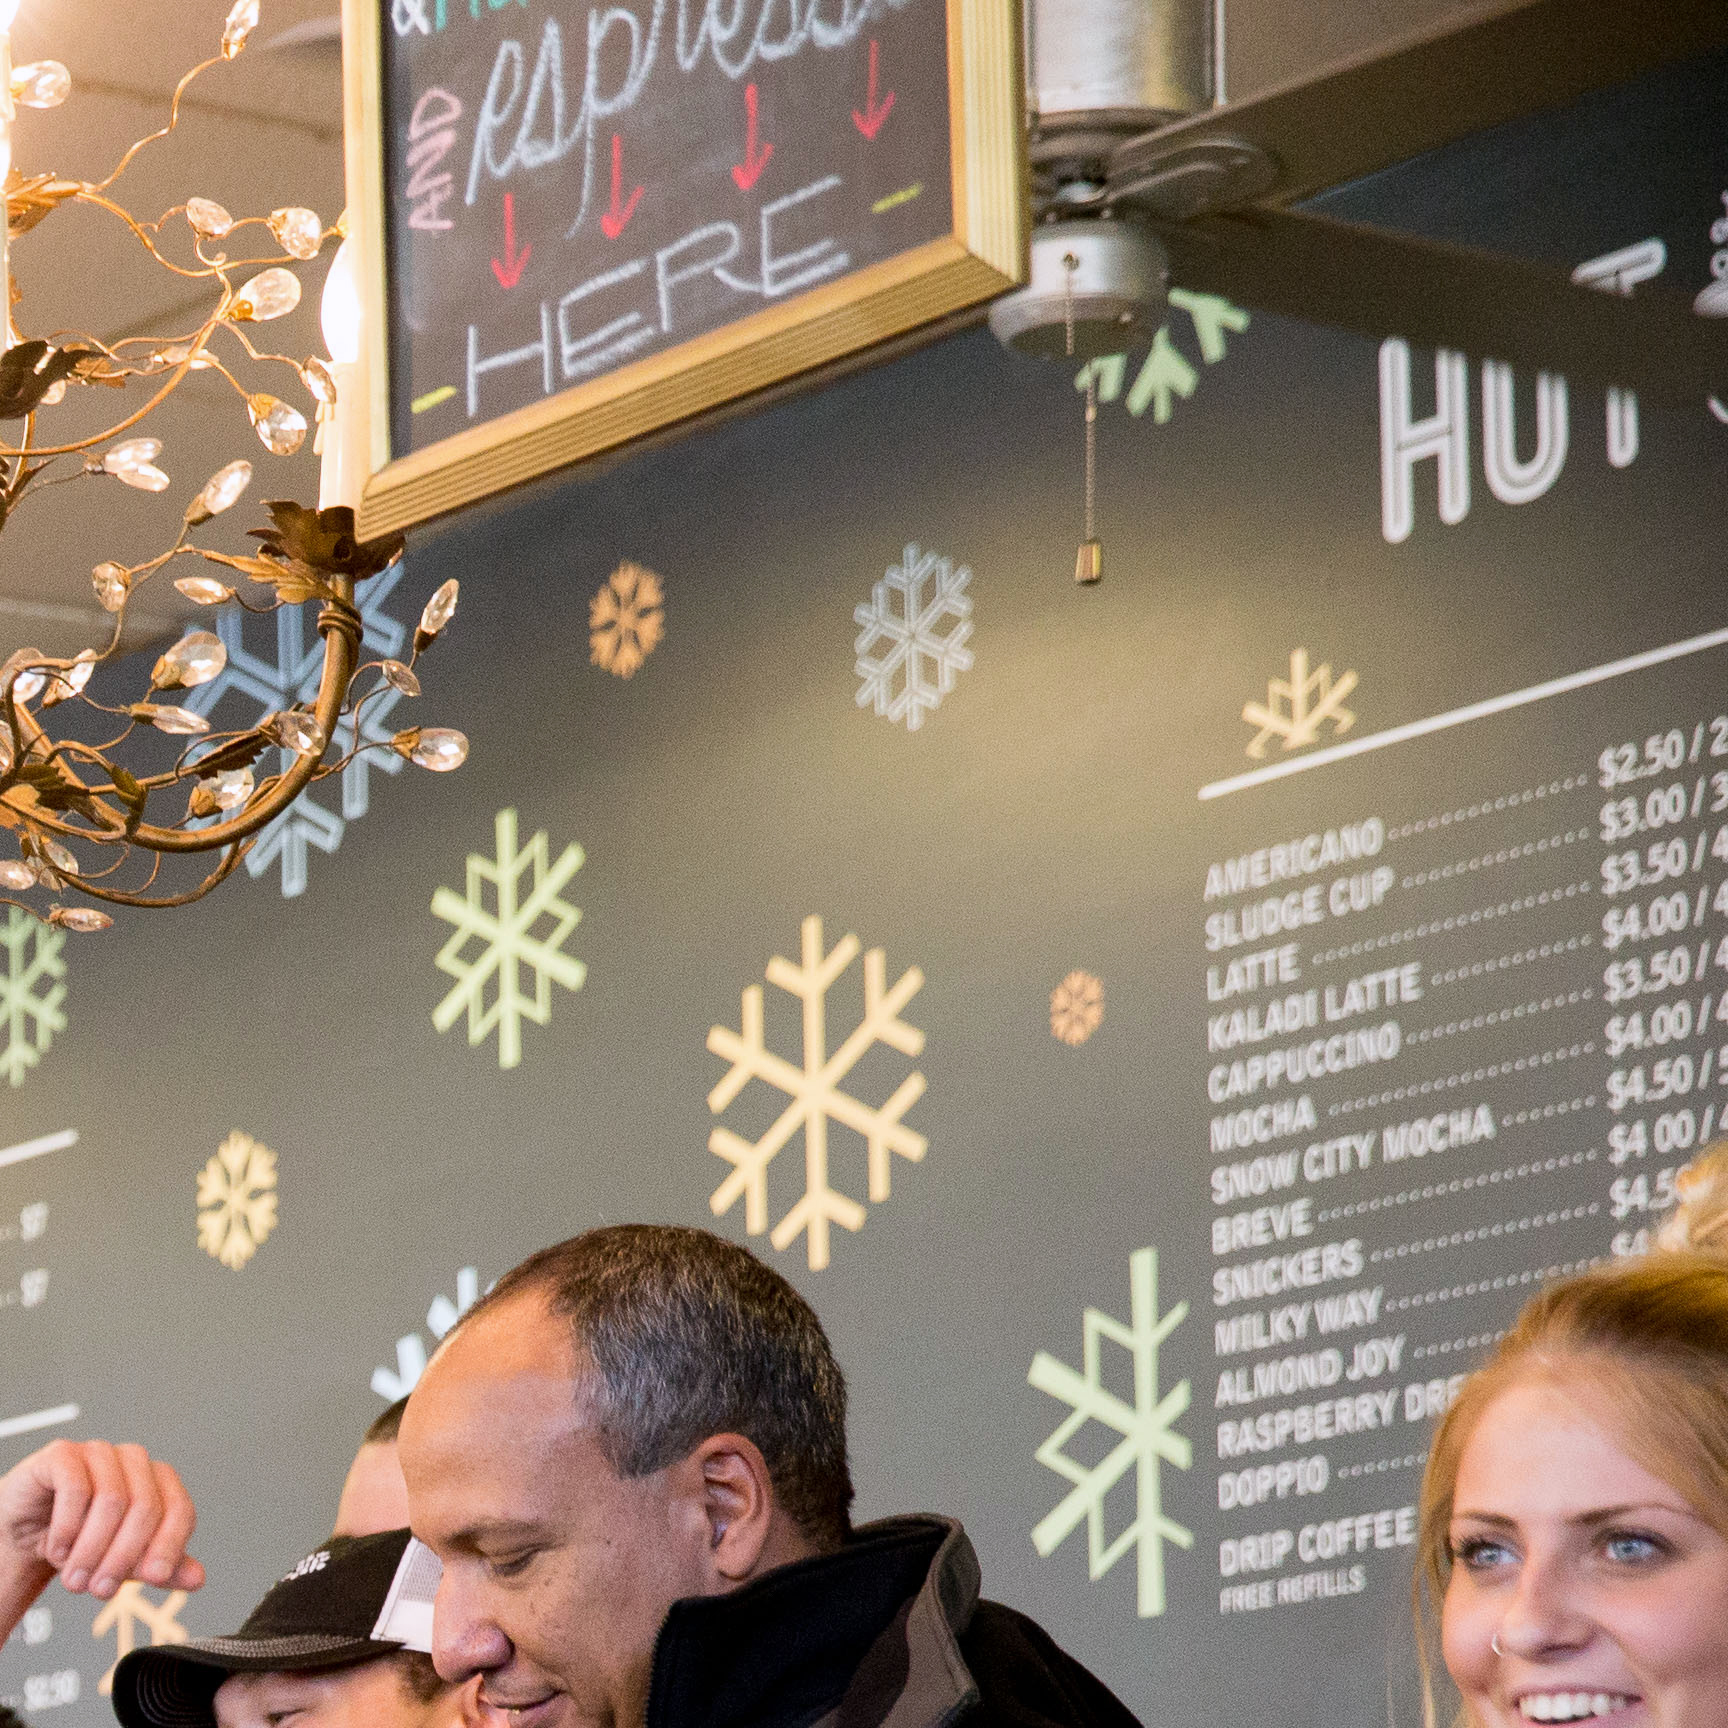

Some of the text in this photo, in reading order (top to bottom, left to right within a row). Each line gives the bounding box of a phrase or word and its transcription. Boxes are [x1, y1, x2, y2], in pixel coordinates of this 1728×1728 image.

[466, 175, 850, 417] HERE
[1204, 816, 1385, 902] AMERICANO
[1598, 727, 1687, 791] $2.50
[1204, 884, 1325, 952] SLUDGE
[1329, 864, 1395, 917] CUP
[1599, 781, 1688, 845] $3.00
[1206, 942, 1302, 1002] LATTE
[1600, 836, 1689, 899] $3.50
[1207, 987, 1320, 1052] KALADI
[1324, 961, 1425, 1023] LATTE
[1601, 889, 1691, 952] $4.00
[1207, 1020, 1403, 1104] CAPPUCCINO
[1602, 944, 1692, 1007] $3.50
[1210, 1093, 1318, 1153] MOCHA
[1605, 1000, 1694, 1058] $4.00
[1210, 1150, 1297, 1205] SNOW
[1302, 1130, 1377, 1184] CITY
[1382, 1102, 1497, 1165] MOCHA
[1606, 1052, 1695, 1113] $4.50
[1211, 1198, 1315, 1257] BREVE
[1212, 1237, 1365, 1307] SNICKERS
[1215, 1284, 1386, 1357] MILKY WAY
[1215, 1332, 1407, 1410] ALMOND JOY
[1217, 1371, 1464, 1461] RASPBERRY DRE
[1217, 1454, 1330, 1512] DOPPIO
[1219, 1506, 1417, 1579] DRIP COFFEE
[1219, 1576, 1275, 1617] FREE
